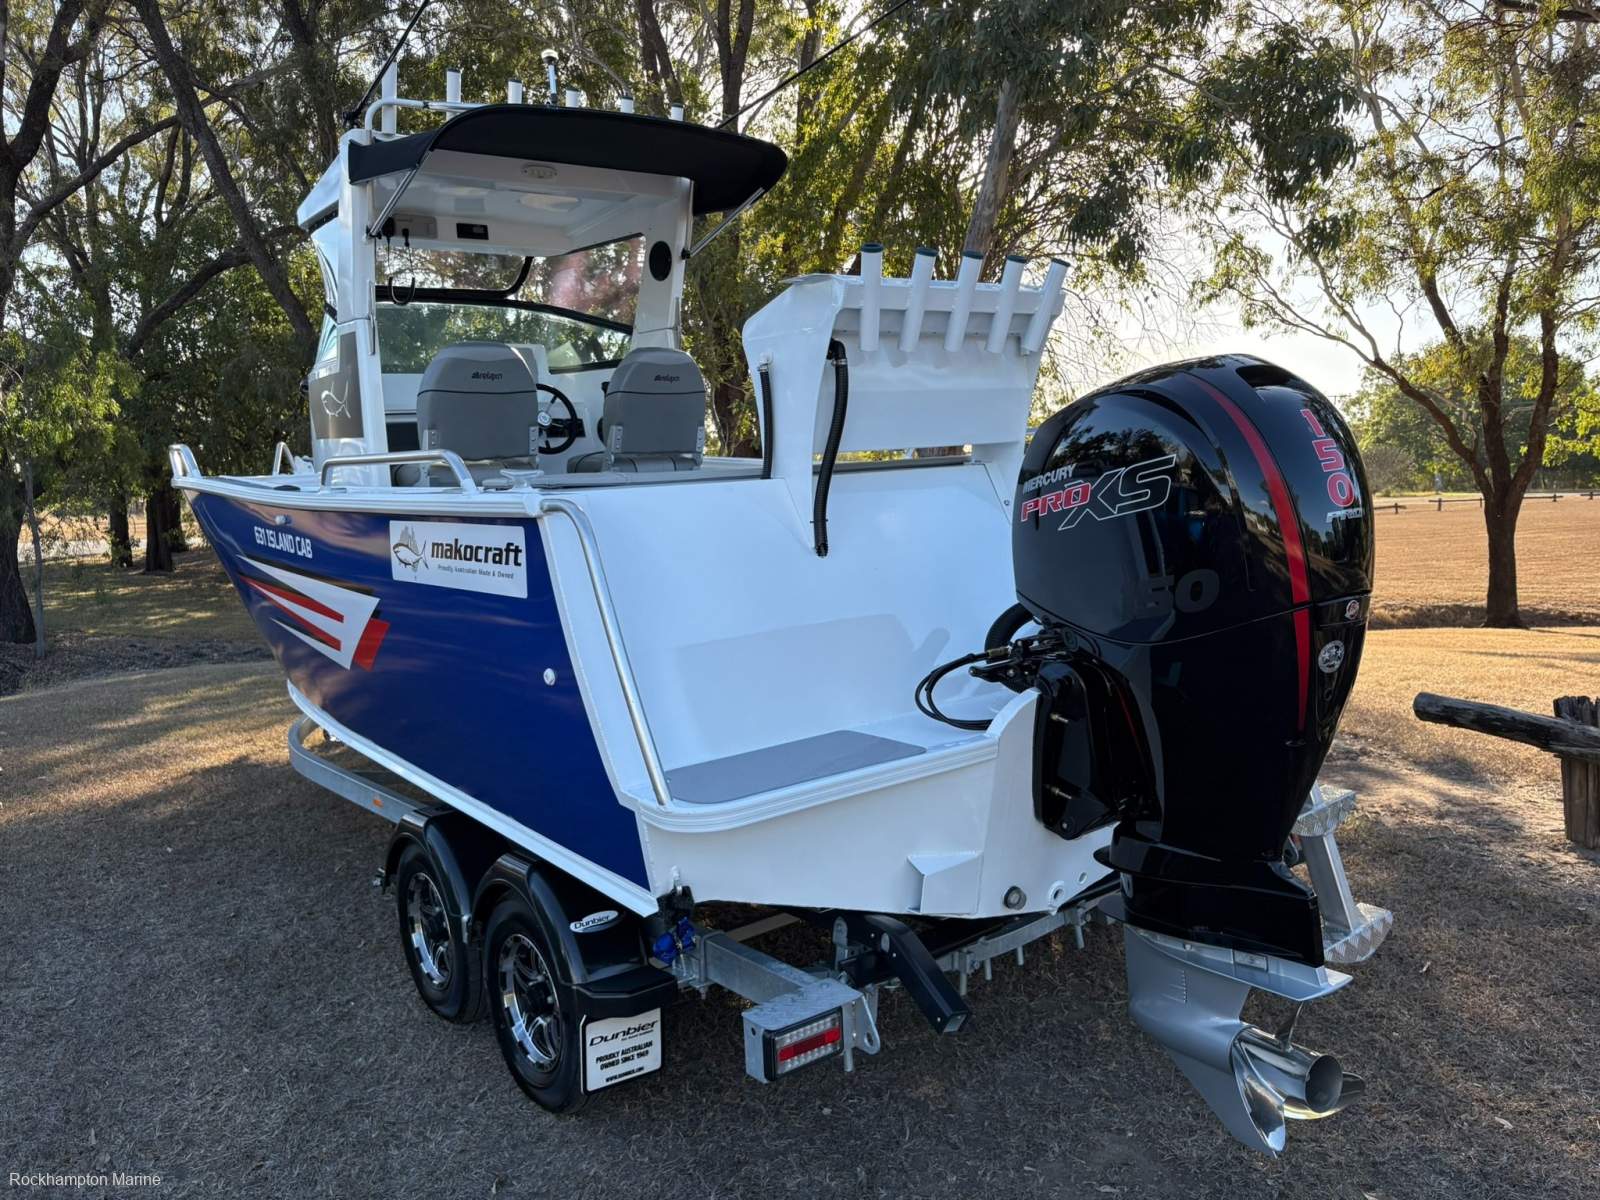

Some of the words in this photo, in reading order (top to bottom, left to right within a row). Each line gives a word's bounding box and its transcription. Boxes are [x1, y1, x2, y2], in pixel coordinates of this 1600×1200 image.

[1300, 408, 1356, 508] 150
[1020, 481, 1093, 522] PRO
[1057, 453, 1177, 531] XS
[1022, 463, 1077, 495] MERCURY
[254, 525, 267, 546] 631
[266, 528, 296, 554] ISLAND
[295, 536, 313, 559] CAB
[431, 537, 523, 567] makocraft
[574, 915, 610, 930] Dunbier
[589, 1020, 658, 1047] Dunbier
[595, 1050, 620, 1064] PROUDLY
[620, 1040, 653, 1056] AUSTRALIAN
[600, 1058, 620, 1071] OWNED
[620, 1054, 635, 1064] SINCE
